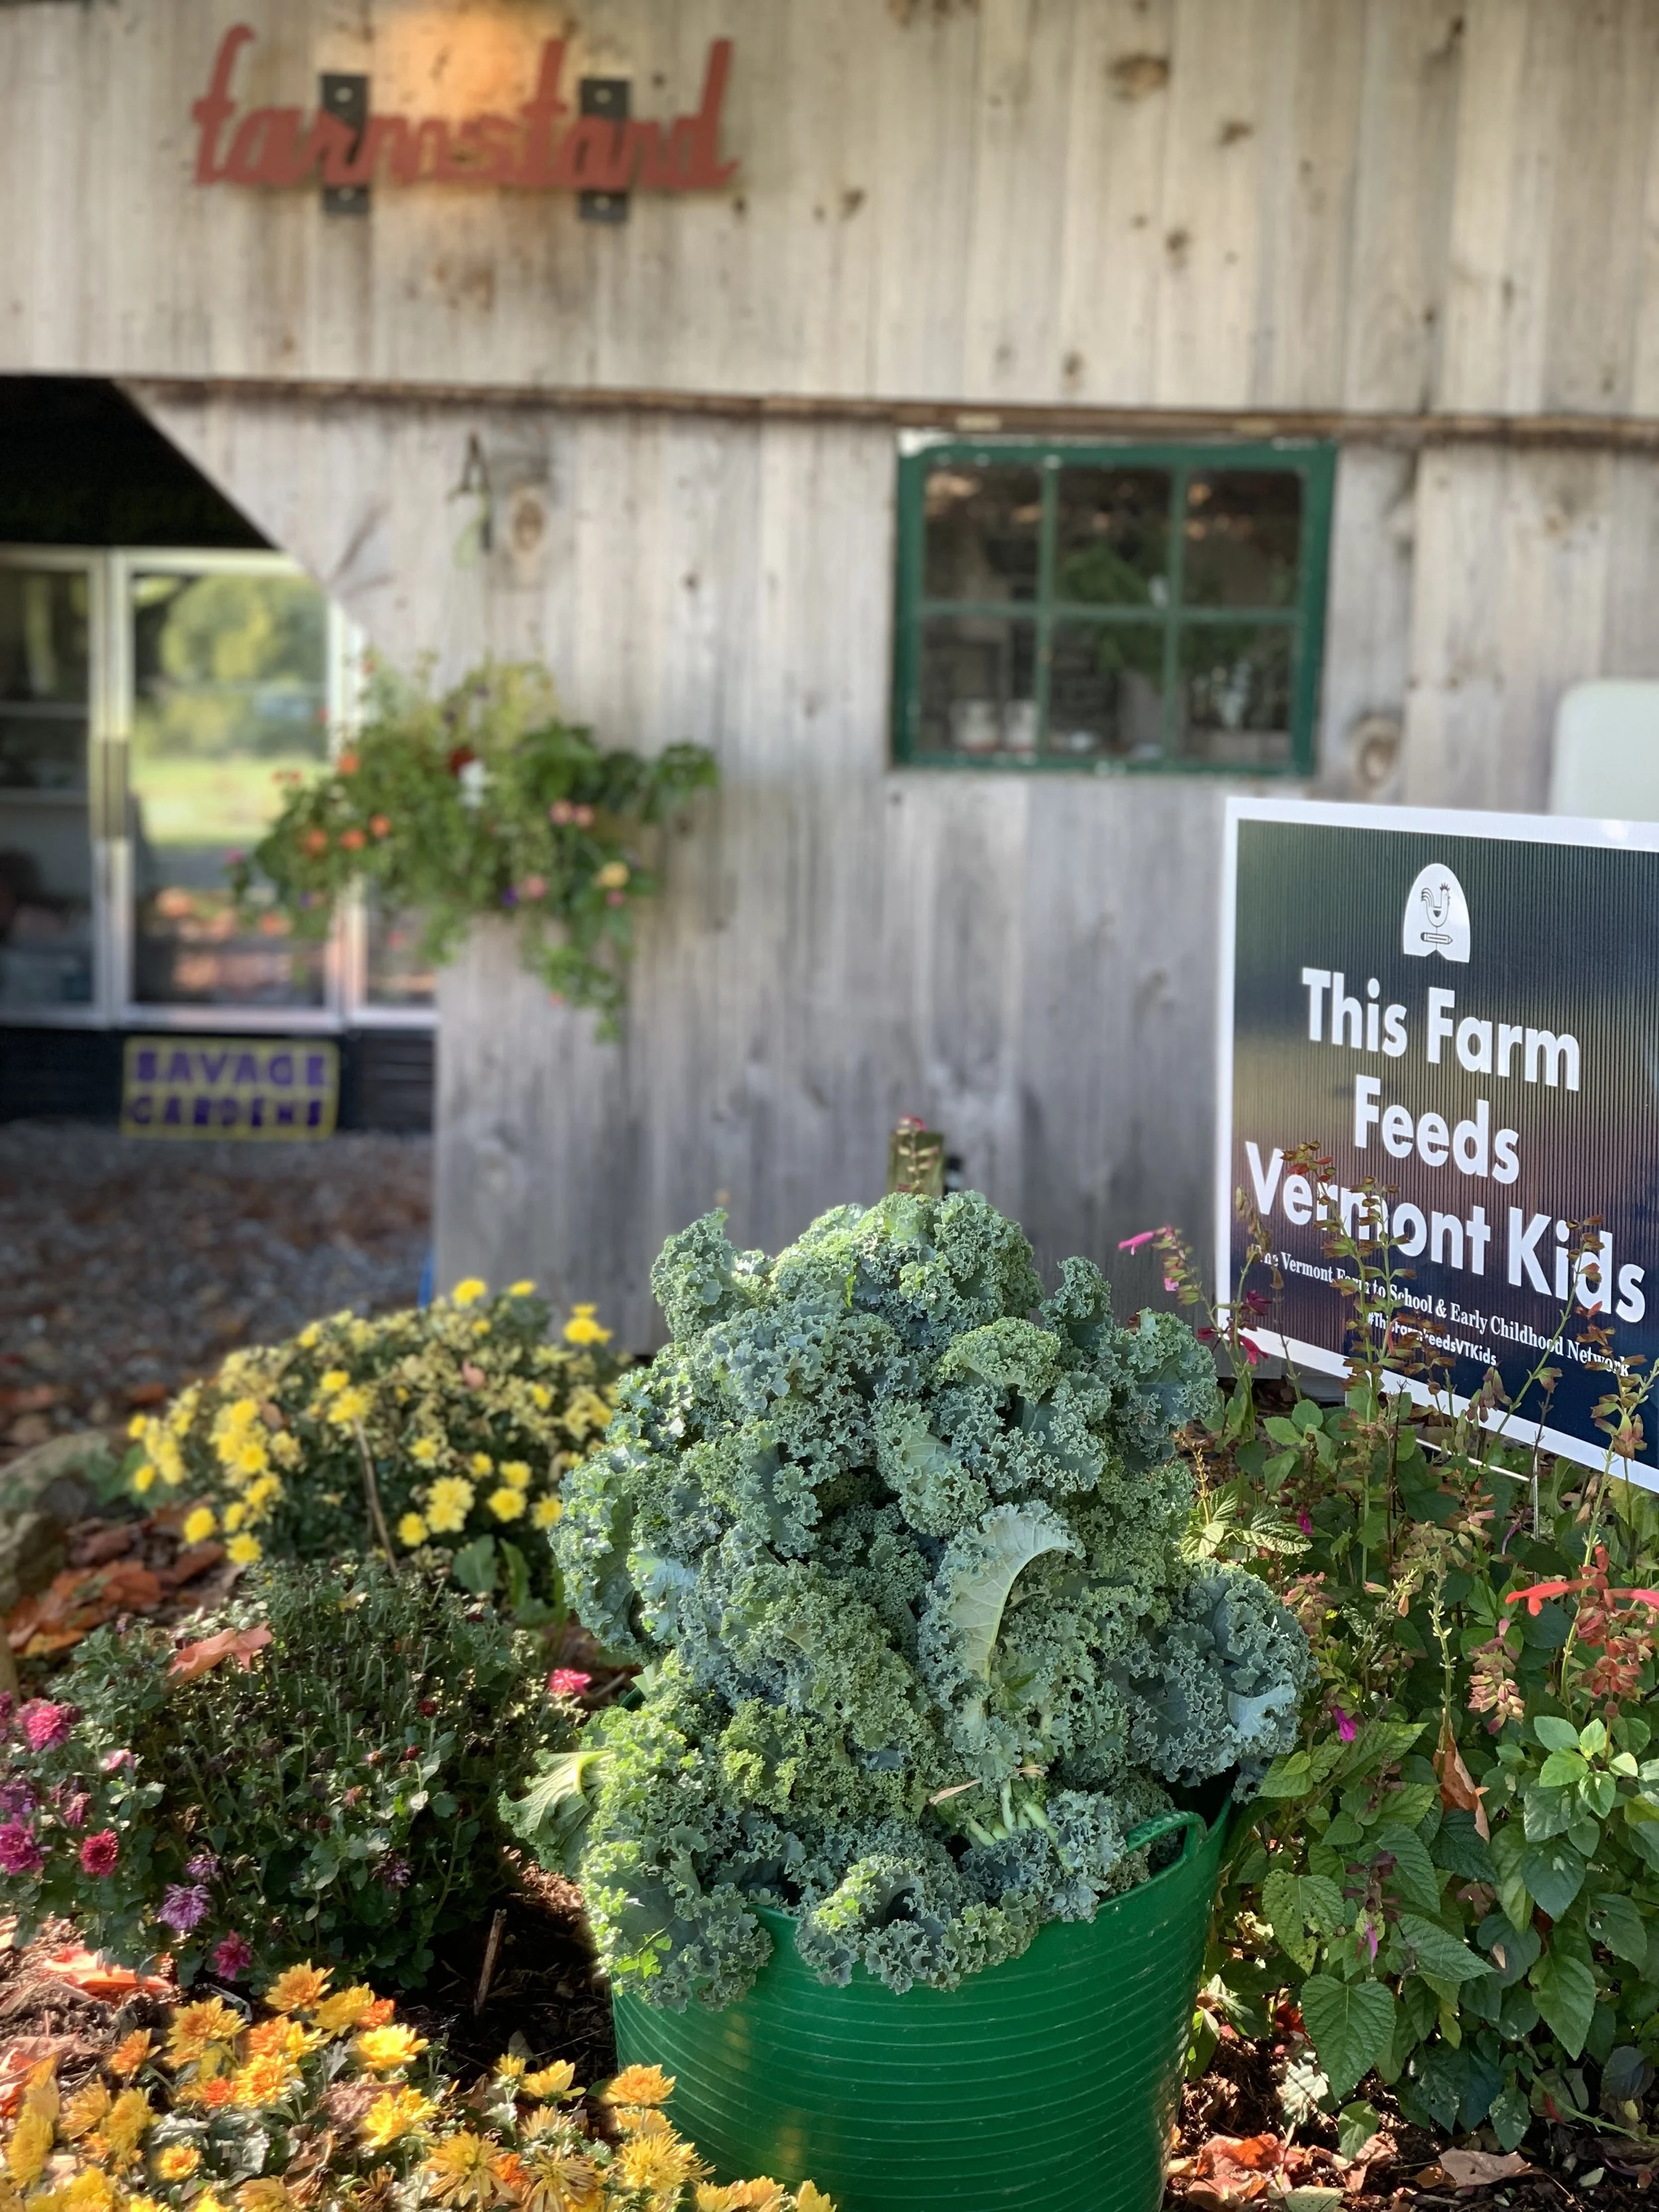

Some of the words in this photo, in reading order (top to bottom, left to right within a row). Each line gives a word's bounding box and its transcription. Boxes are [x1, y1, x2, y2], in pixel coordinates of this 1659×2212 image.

[190, 23, 740, 191] farmstand
[137, 1051, 325, 1087] SAVAGE
[1302, 967, 1407, 1057] This
[1427, 986, 1580, 1091] Farm
[1355, 1074, 1520, 1185] Feeds
[1245, 1141, 1491, 1276] Vermont
[1508, 1206, 1646, 1323] Kids
[1256, 1248, 1279, 1267] he
[1281, 1251, 1333, 1283] Vermont
[1373, 1280, 1386, 1299] to
[1390, 1284, 1433, 1314] School
[1435, 1298, 1447, 1318] &
[1450, 1301, 1488, 1335] Early
[1490, 1316, 1563, 1357] Childhood
